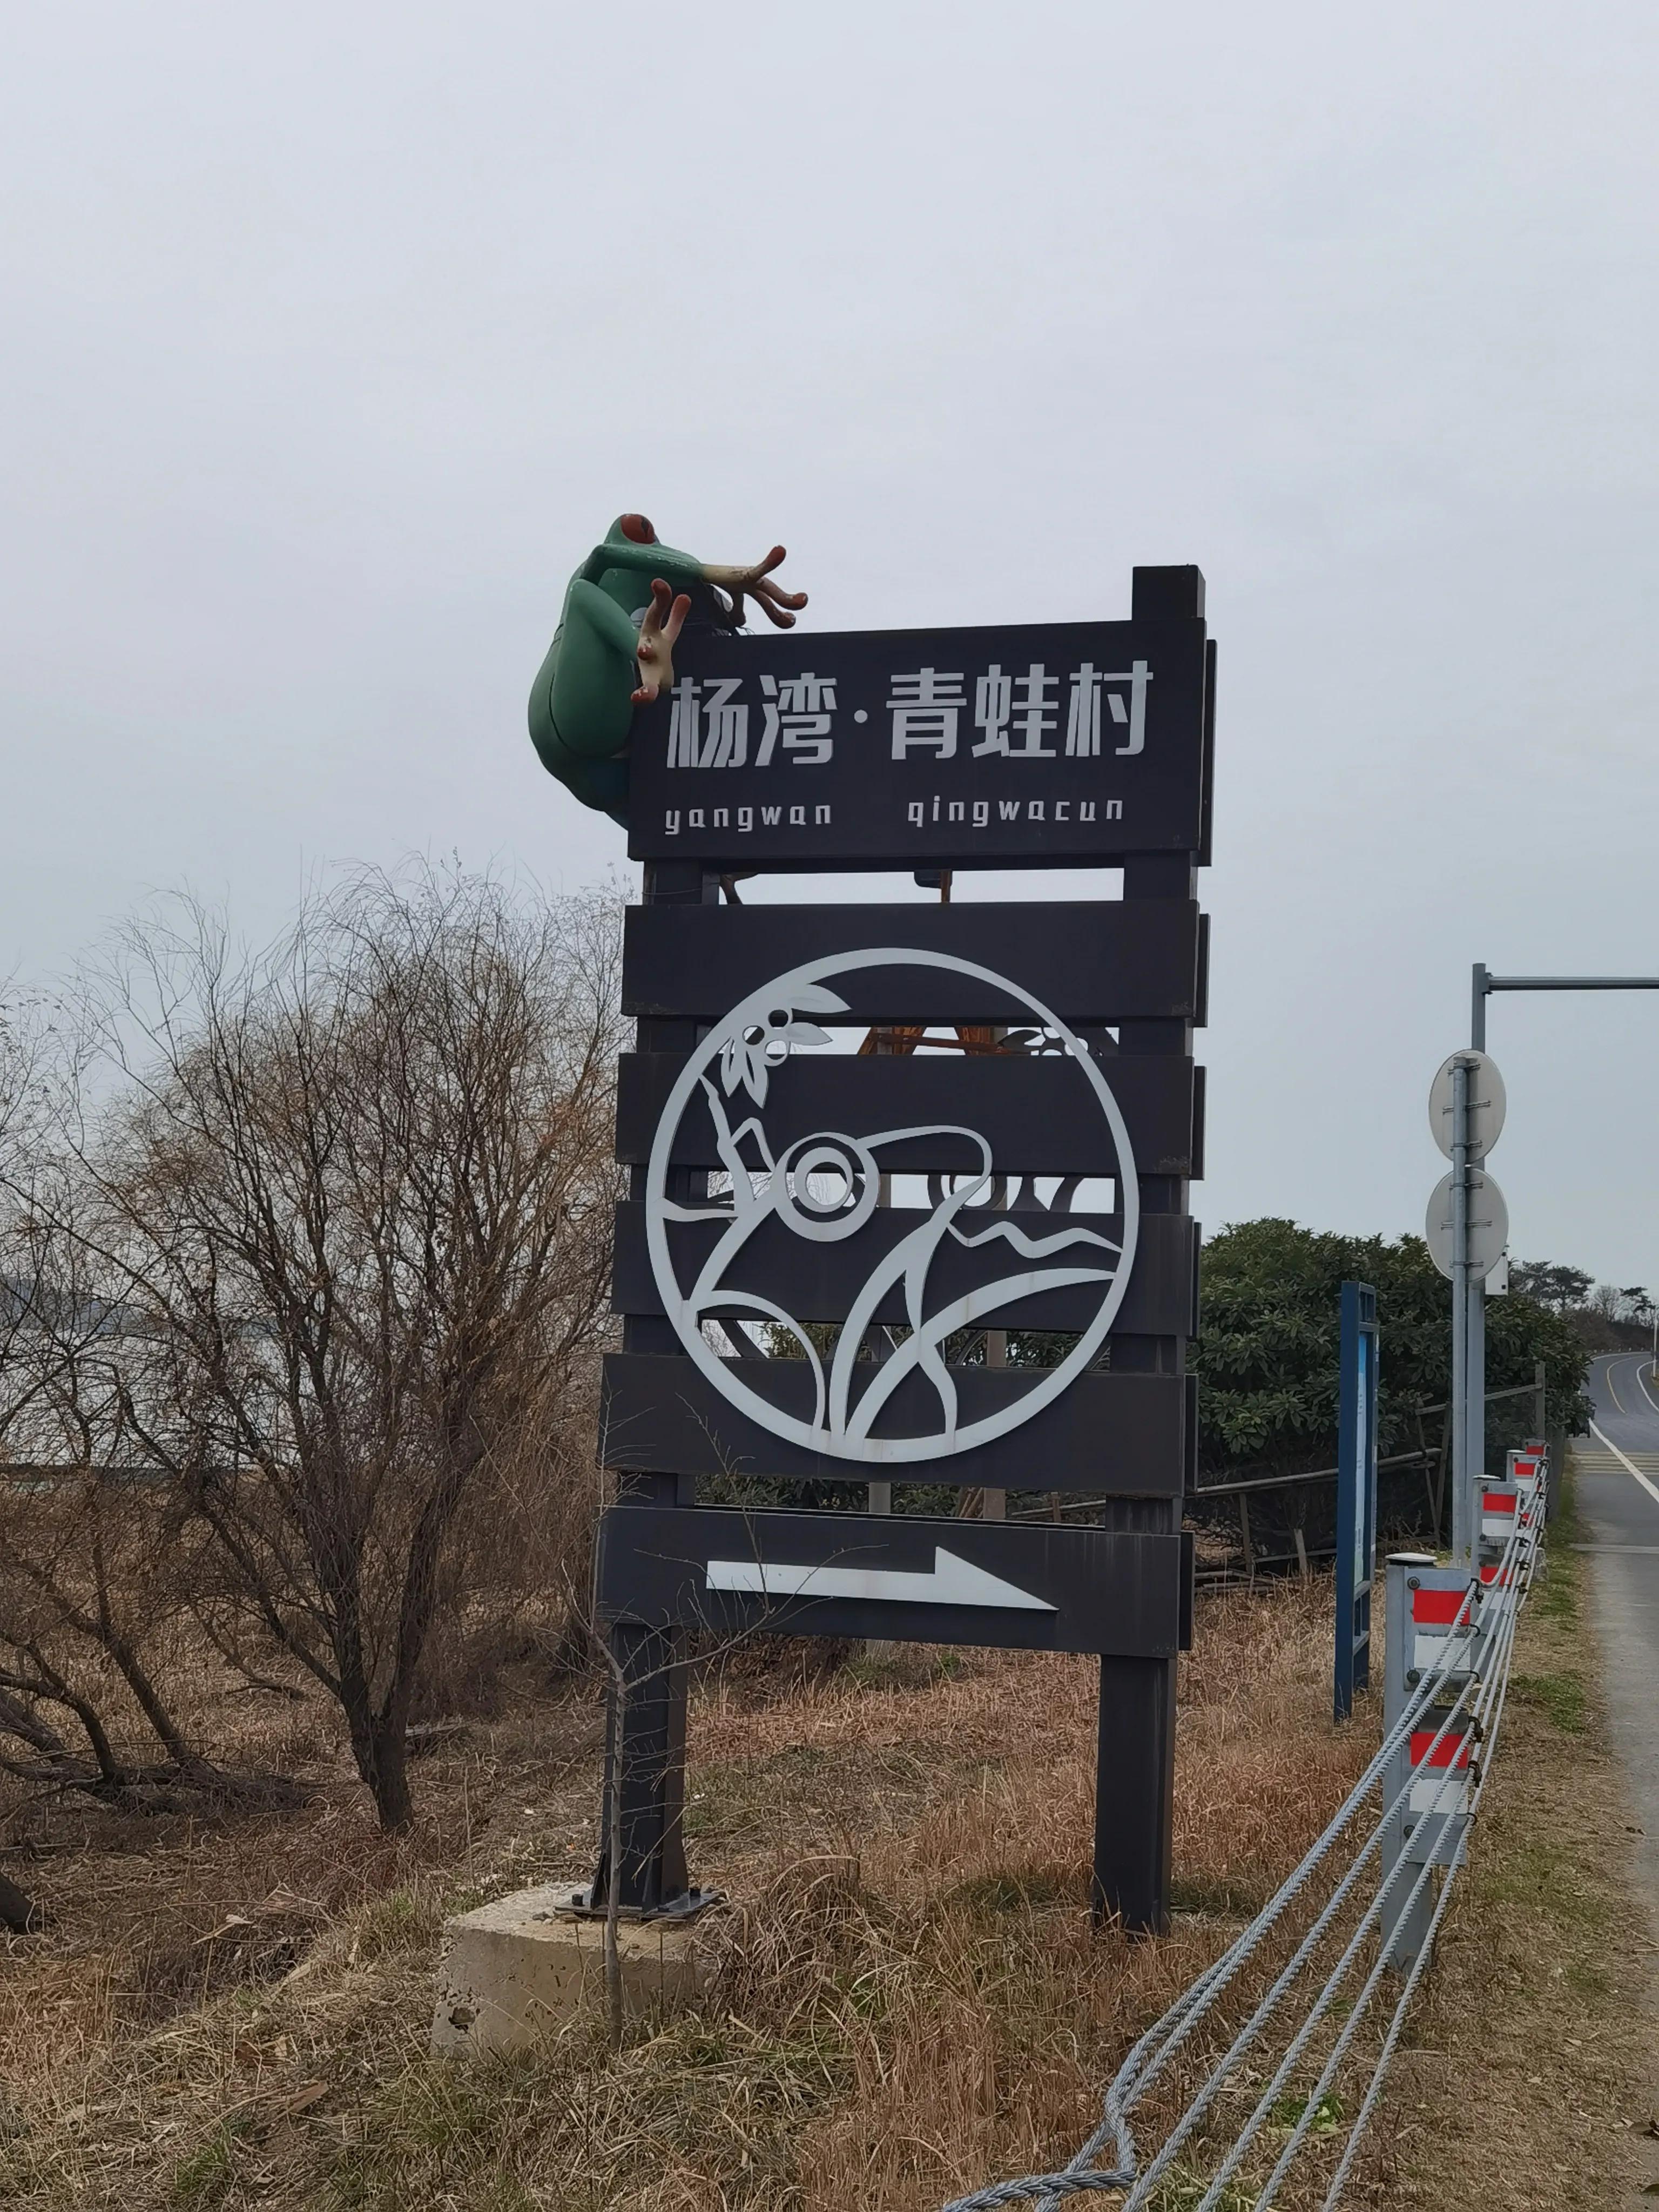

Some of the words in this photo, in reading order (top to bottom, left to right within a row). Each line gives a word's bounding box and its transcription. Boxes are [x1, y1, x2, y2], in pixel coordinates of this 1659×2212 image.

[666, 660, 1154, 768] 杨湾·青蛙村
[664, 805, 831, 835] yangwan
[907, 795, 1123, 828] qingwacun
